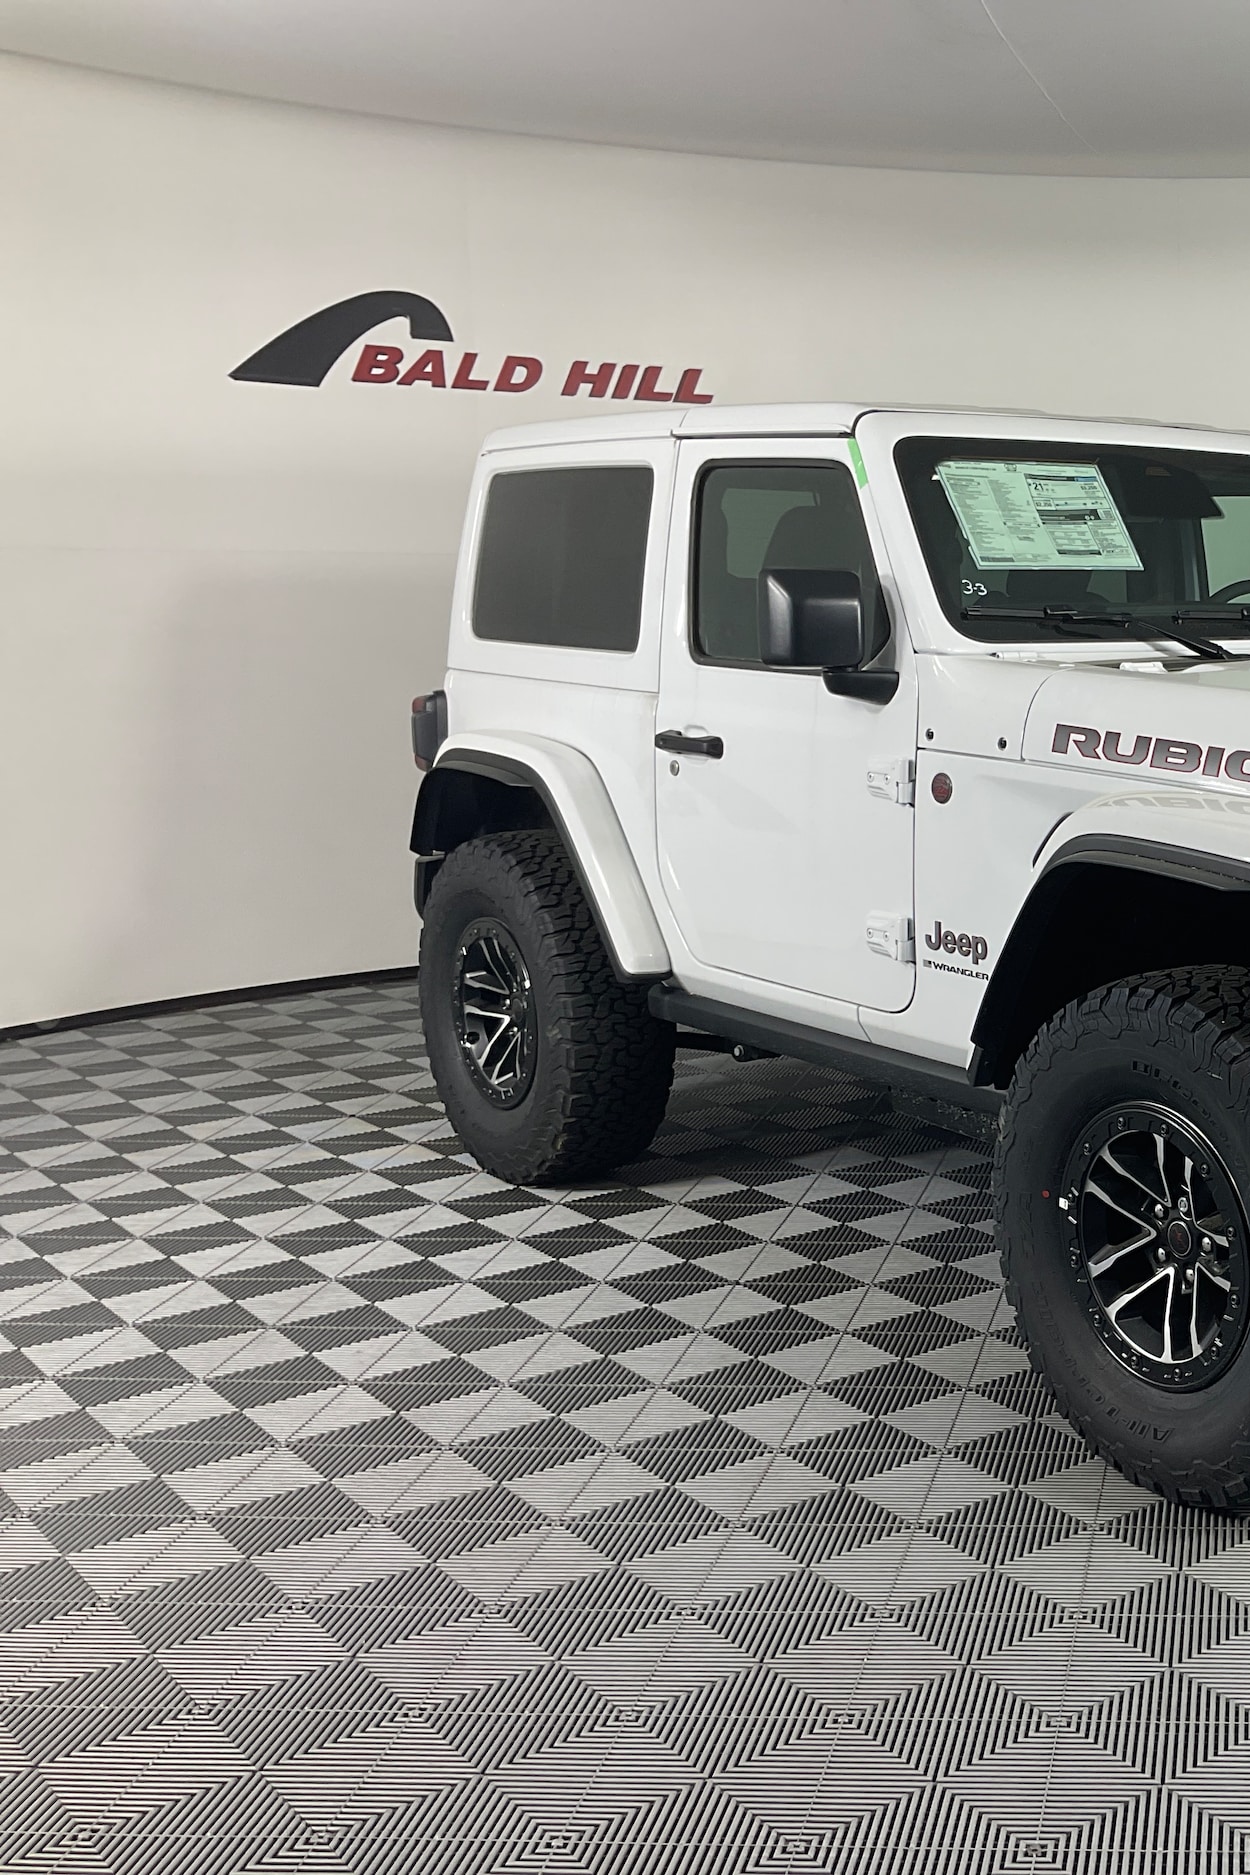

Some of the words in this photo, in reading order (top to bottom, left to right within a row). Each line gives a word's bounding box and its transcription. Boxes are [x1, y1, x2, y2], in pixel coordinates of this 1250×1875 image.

[351, 344, 543, 393] BALD
[560, 360, 715, 405] HILL
[924, 920, 988, 966] Jeep
[932, 961, 989, 981] WRANGLER
